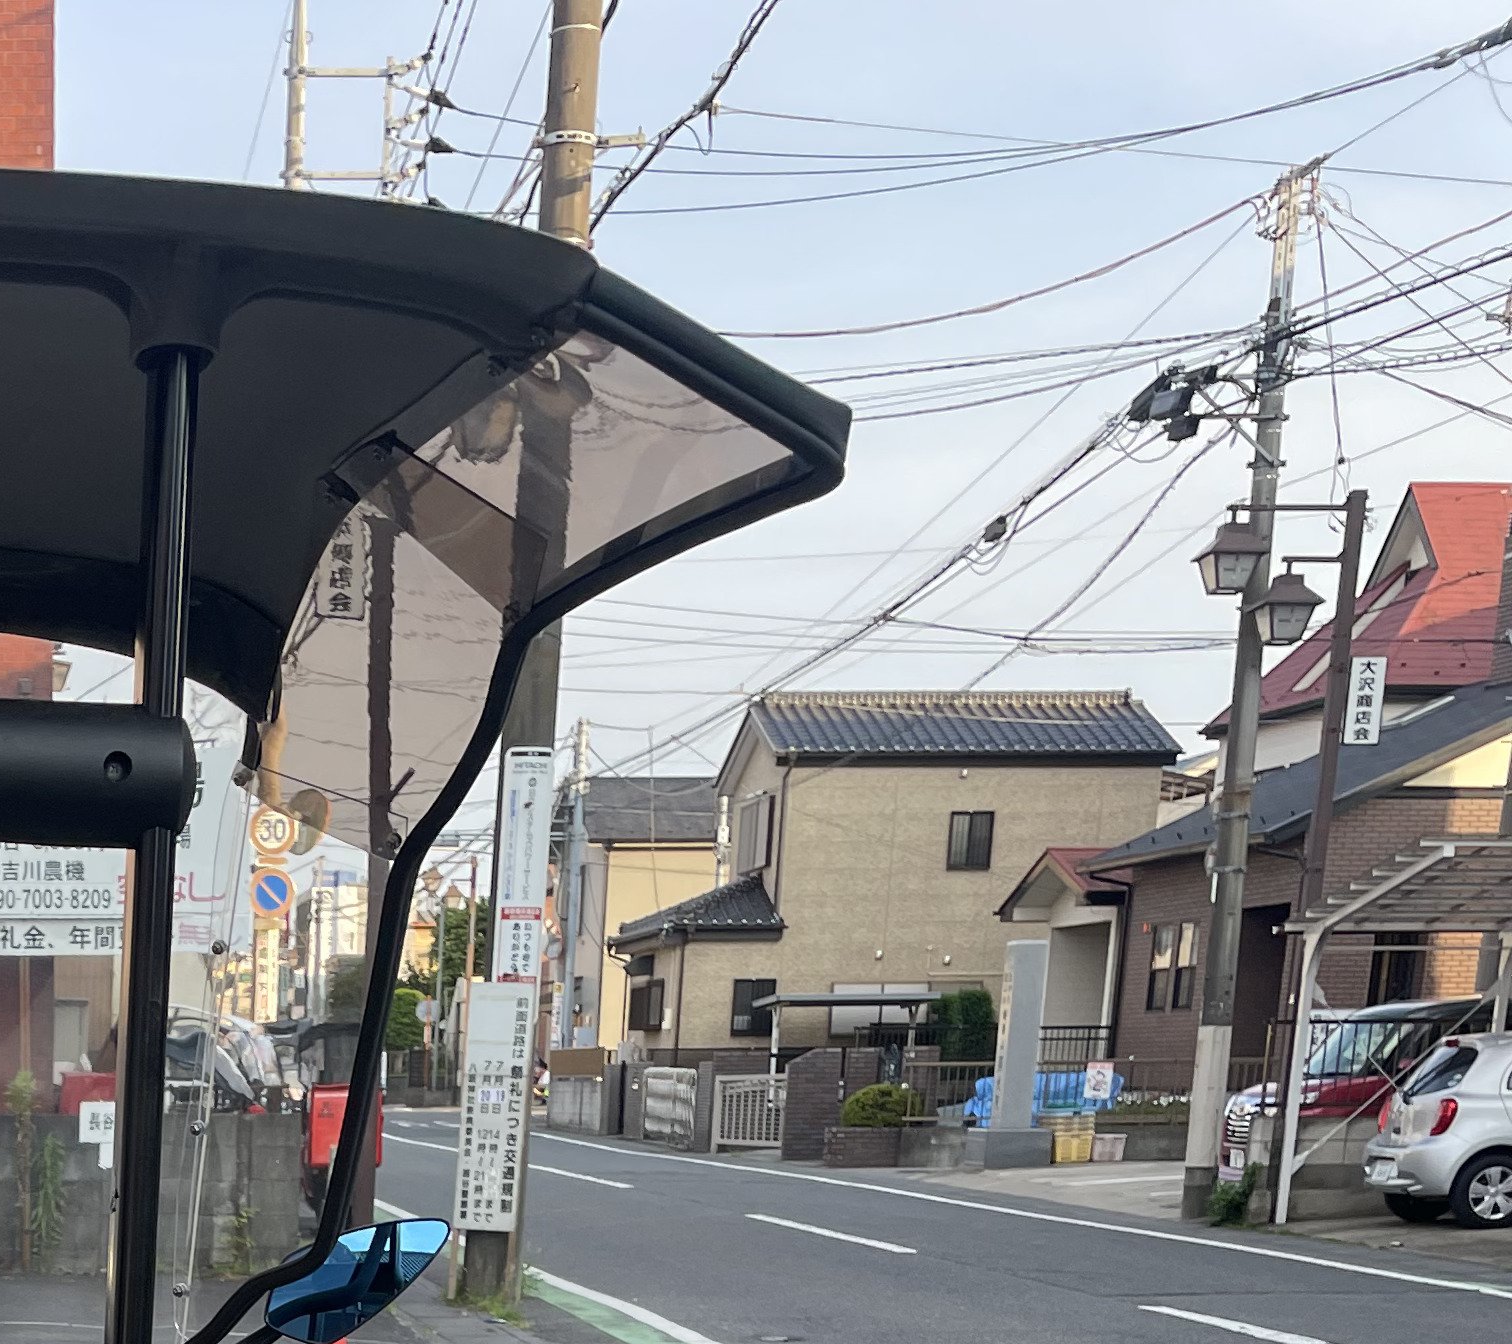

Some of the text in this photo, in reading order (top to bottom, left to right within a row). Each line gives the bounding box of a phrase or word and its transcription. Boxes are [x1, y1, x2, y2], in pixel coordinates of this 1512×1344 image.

[1353, 661, 1377, 741] 大沢商店会
[259, 817, 287, 842] 30
